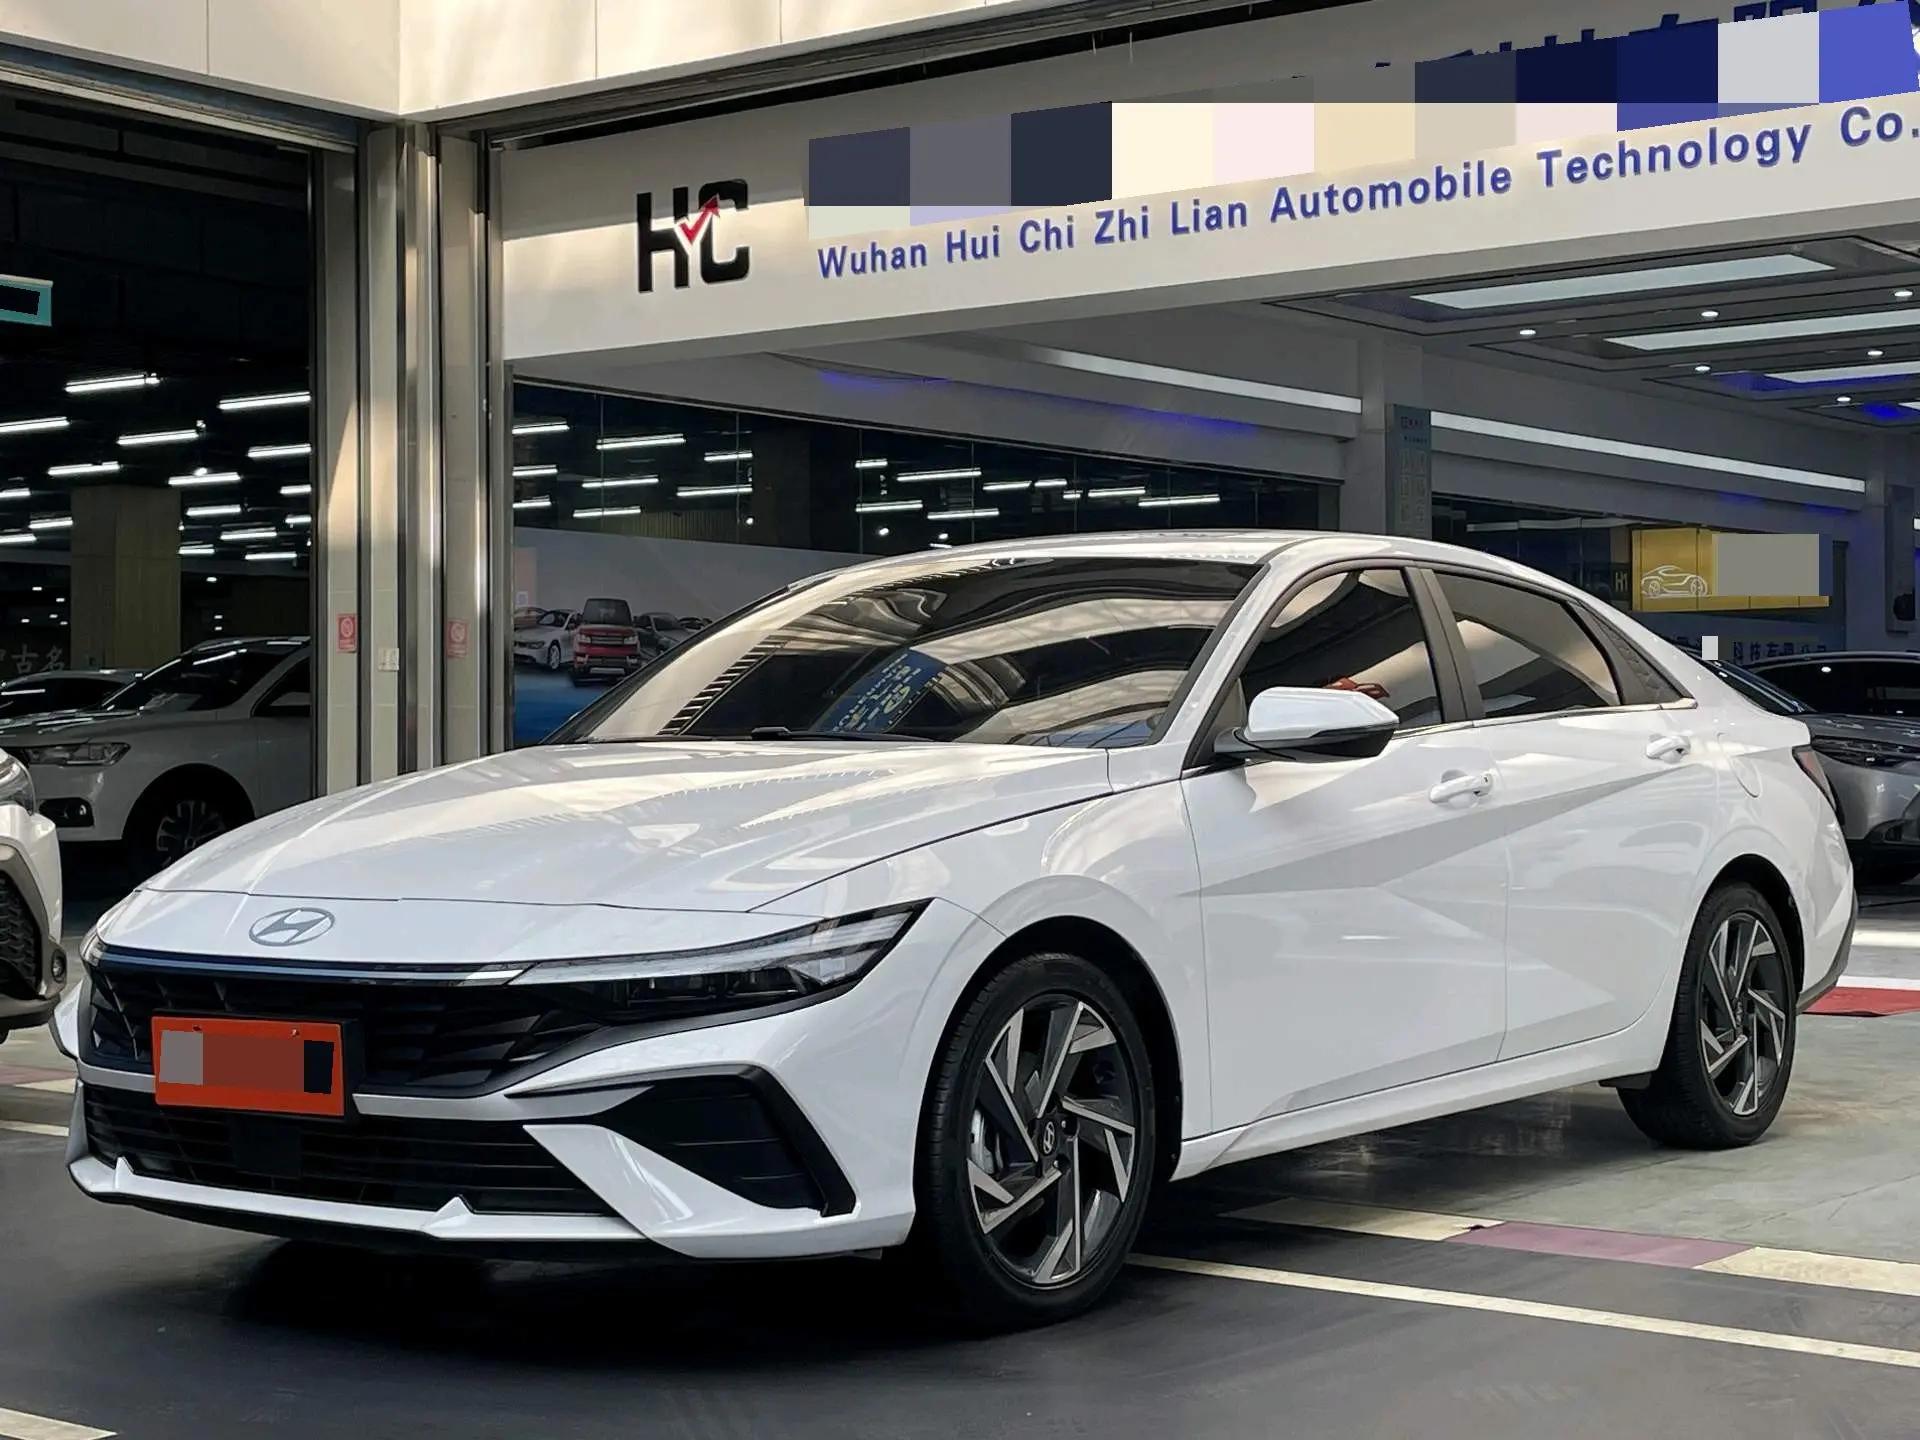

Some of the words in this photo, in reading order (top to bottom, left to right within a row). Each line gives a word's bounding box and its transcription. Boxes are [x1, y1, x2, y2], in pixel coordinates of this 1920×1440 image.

[817, 241, 928, 280] Wuhan
[946, 225, 1000, 264] Hui
[1019, 215, 1074, 254] Chi
[1094, 205, 1150, 245] Zhi
[1171, 198, 1248, 236] Lian
[1270, 160, 1512, 223] Automobile
[1536, 124, 1812, 188] Technology
[1840, 106, 1919, 148] Co.
